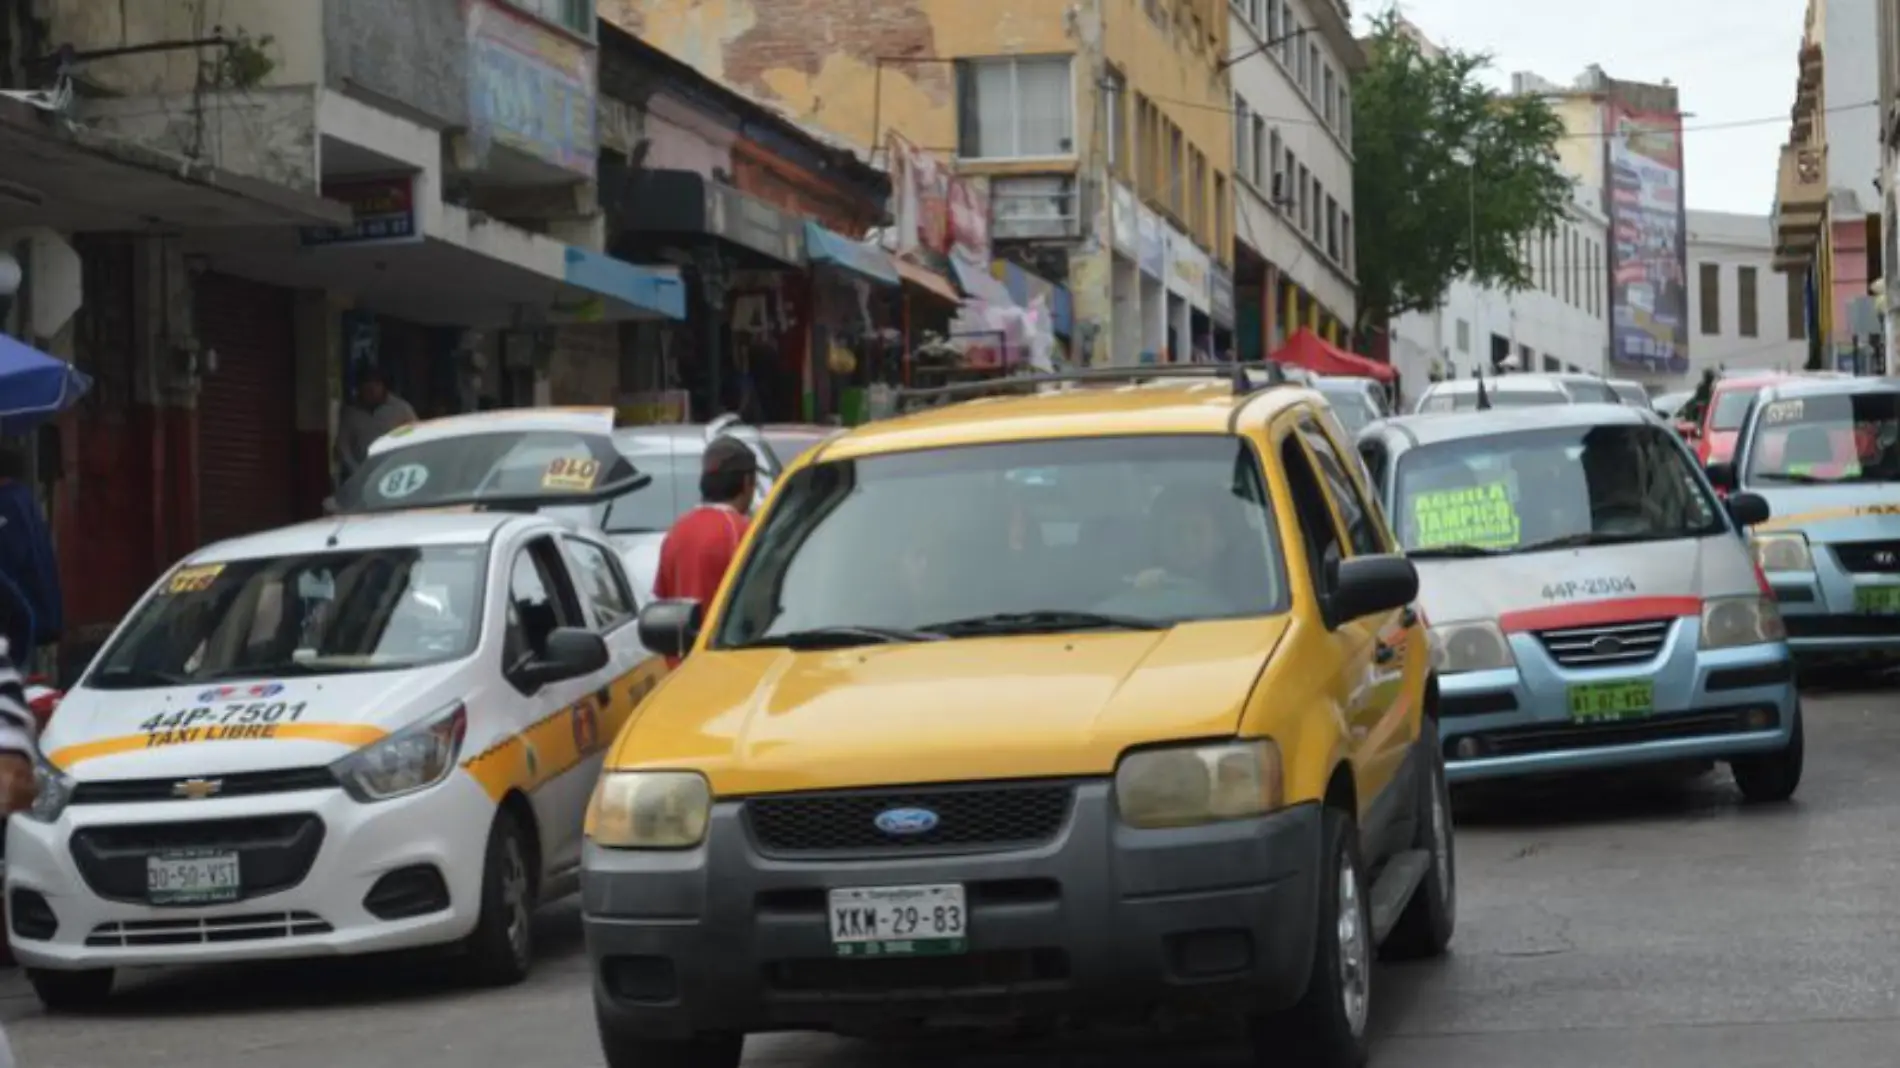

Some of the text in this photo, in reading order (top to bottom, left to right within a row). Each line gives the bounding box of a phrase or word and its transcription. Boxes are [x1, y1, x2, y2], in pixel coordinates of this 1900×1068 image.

[1419, 503, 1514, 535] TAMPICO
[1540, 576, 1637, 600] 44P-2504
[140, 701, 307, 731] 44P-7501
[147, 723, 279, 748] TAXI LIBRE
